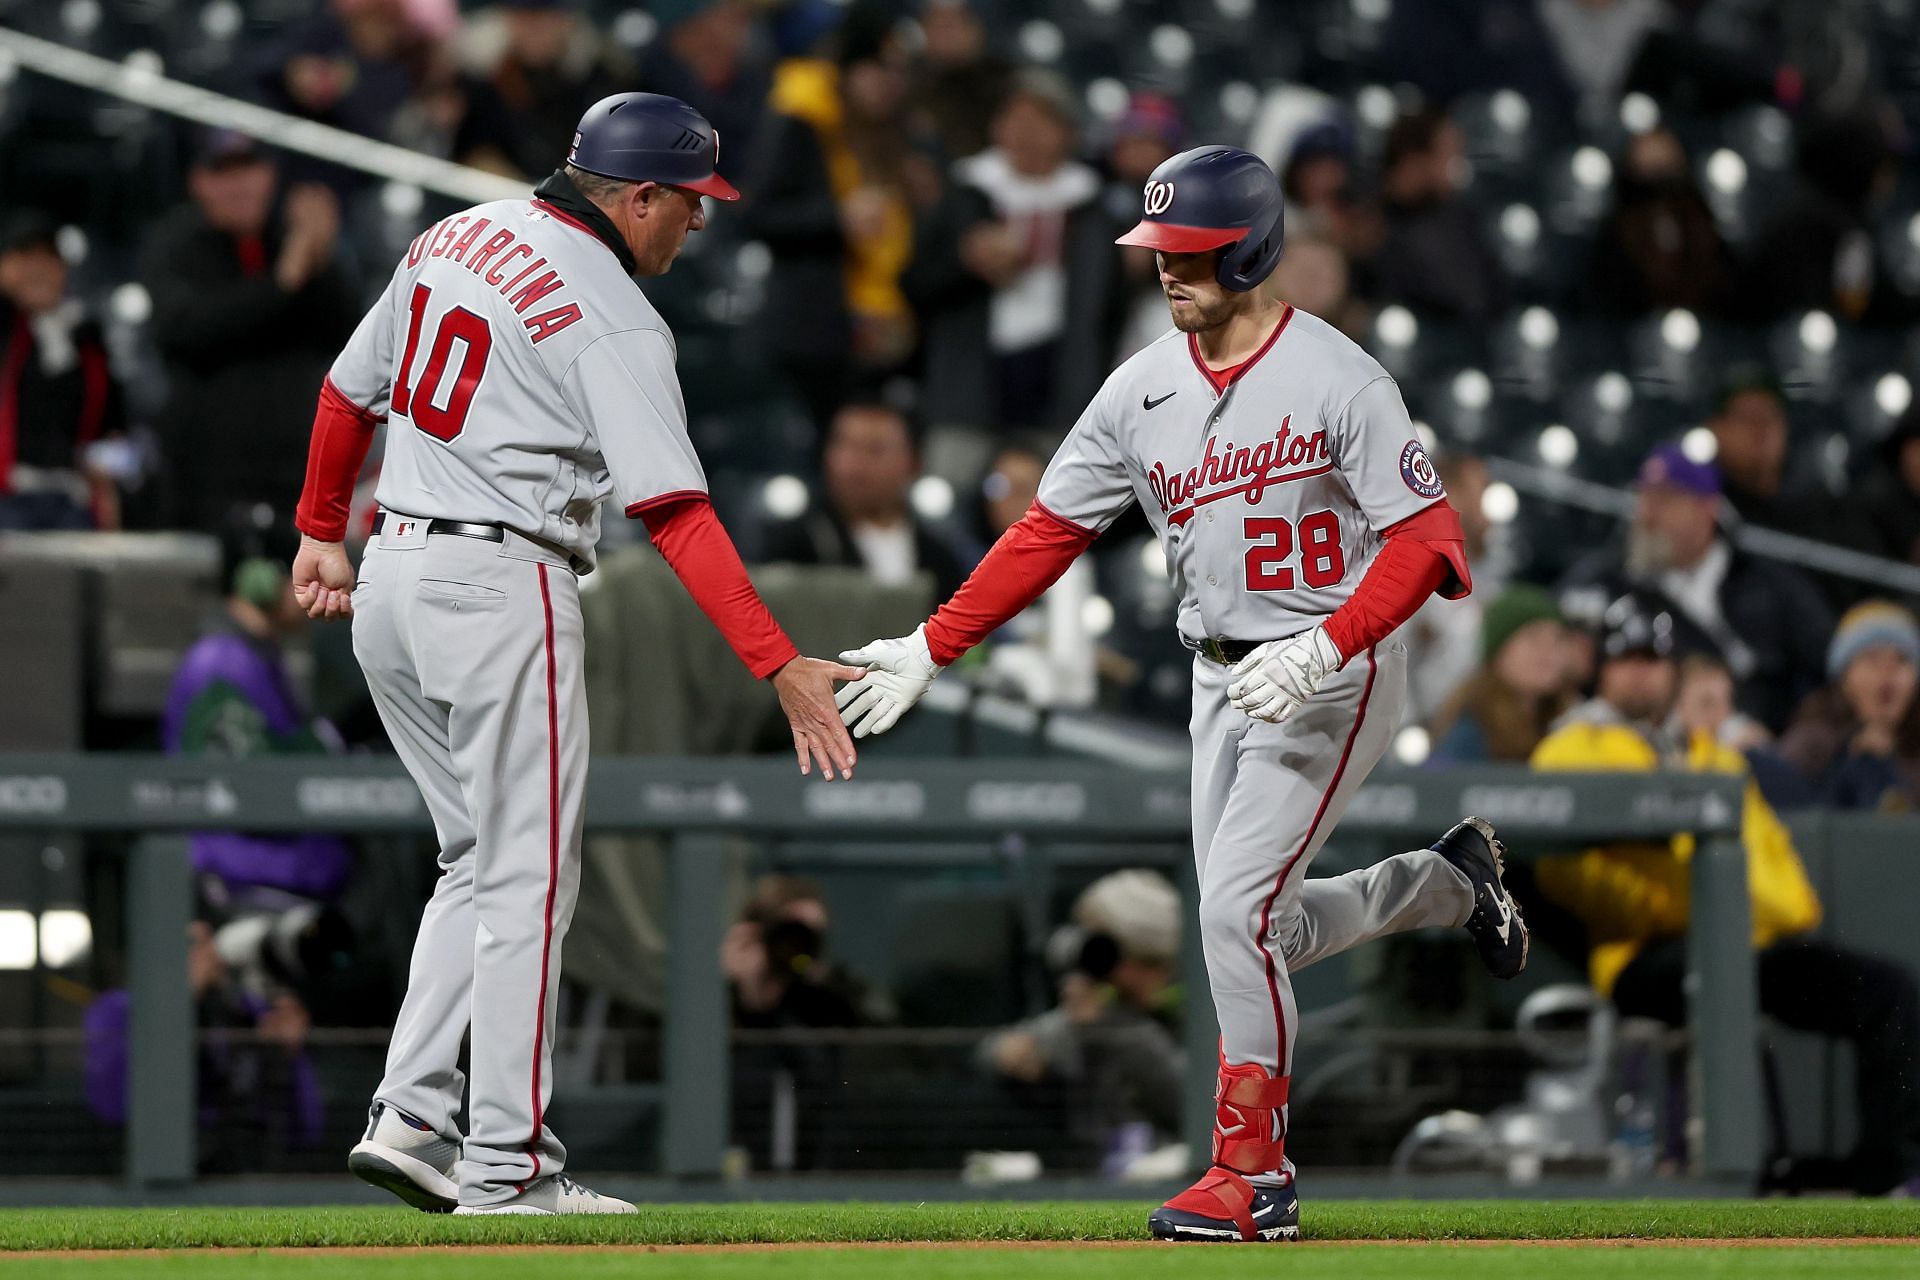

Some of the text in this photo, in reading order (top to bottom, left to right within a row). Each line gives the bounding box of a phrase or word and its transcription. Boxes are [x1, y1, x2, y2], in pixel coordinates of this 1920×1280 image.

[1143, 180, 1175, 216] W
[407, 215, 585, 346] DISARCINA
[390, 281, 493, 446] 10
[1148, 411, 1332, 516] Washington
[1243, 508, 1346, 592] 28
